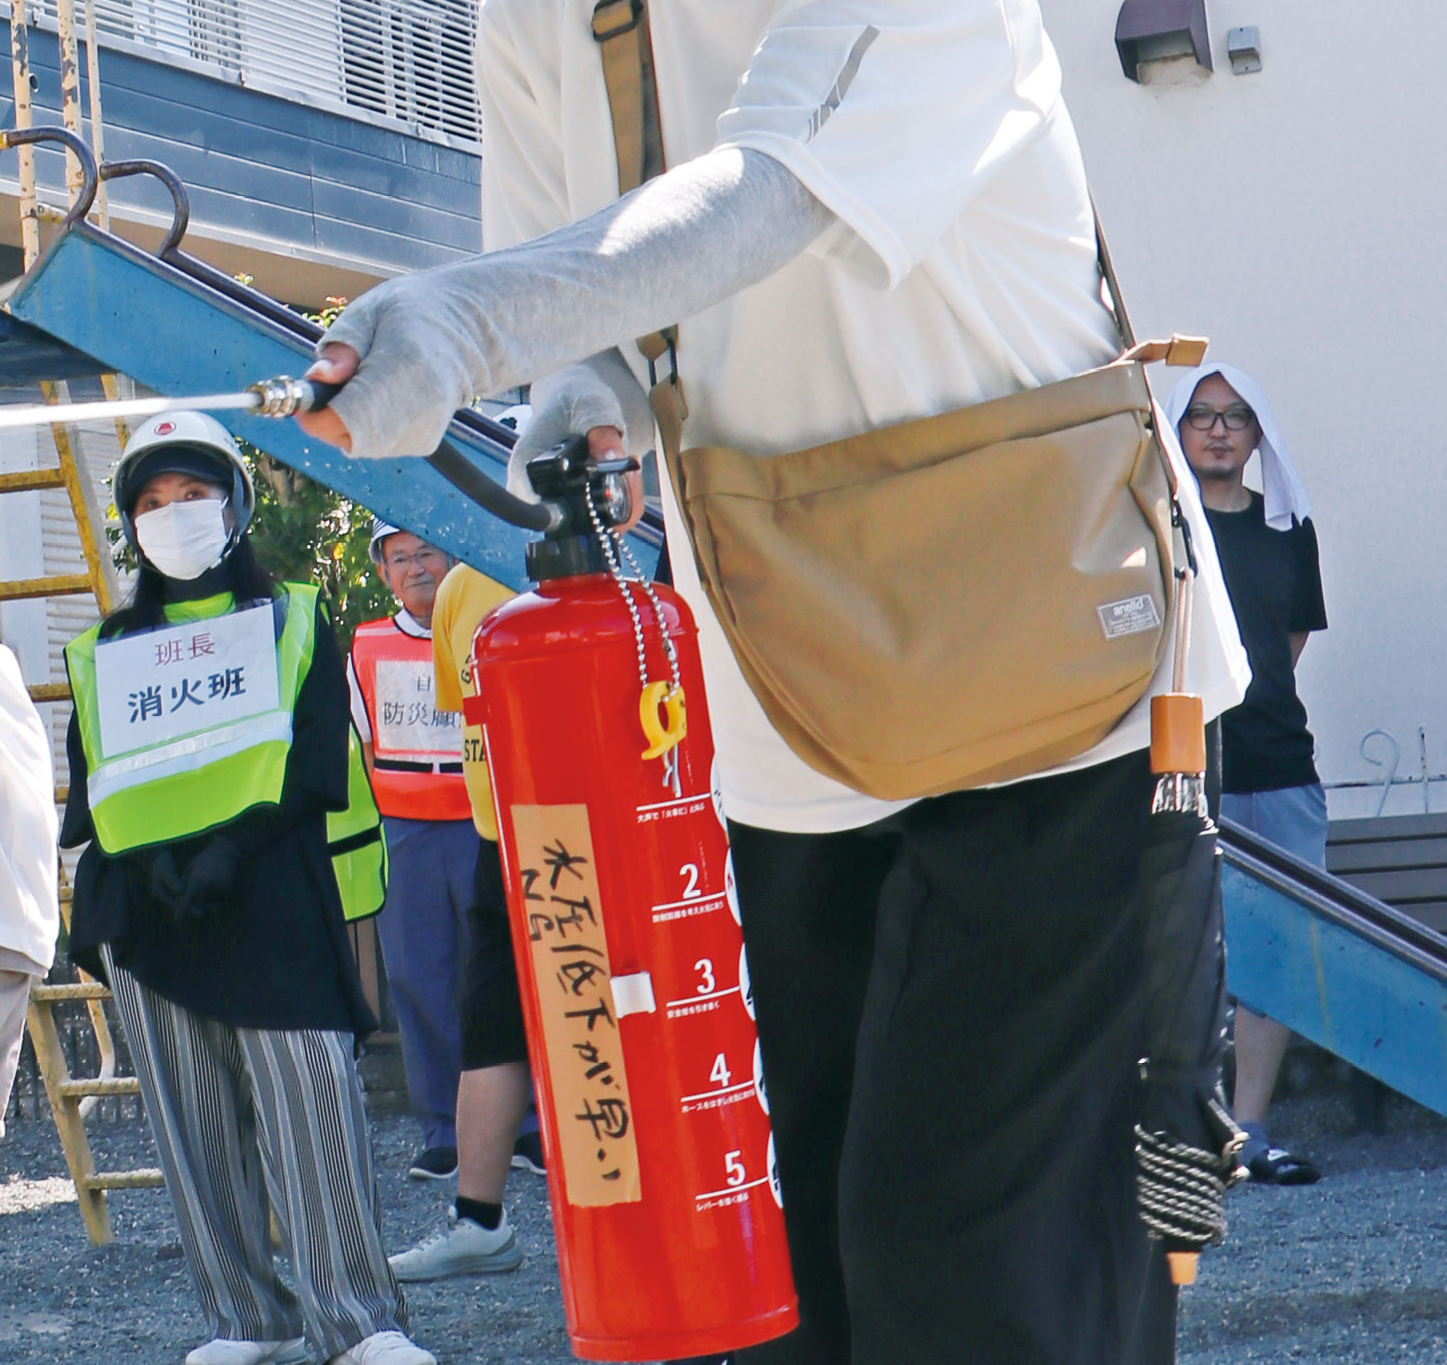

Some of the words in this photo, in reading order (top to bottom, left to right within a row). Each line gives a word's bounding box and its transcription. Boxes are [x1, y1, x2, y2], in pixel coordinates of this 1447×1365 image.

[154, 632, 216, 667] 班長
[127, 666, 247, 724] 消火班
[679, 863, 702, 900] 2
[694, 958, 716, 994] 3
[709, 1052, 732, 1087] 4
[724, 1149, 746, 1186] 5
